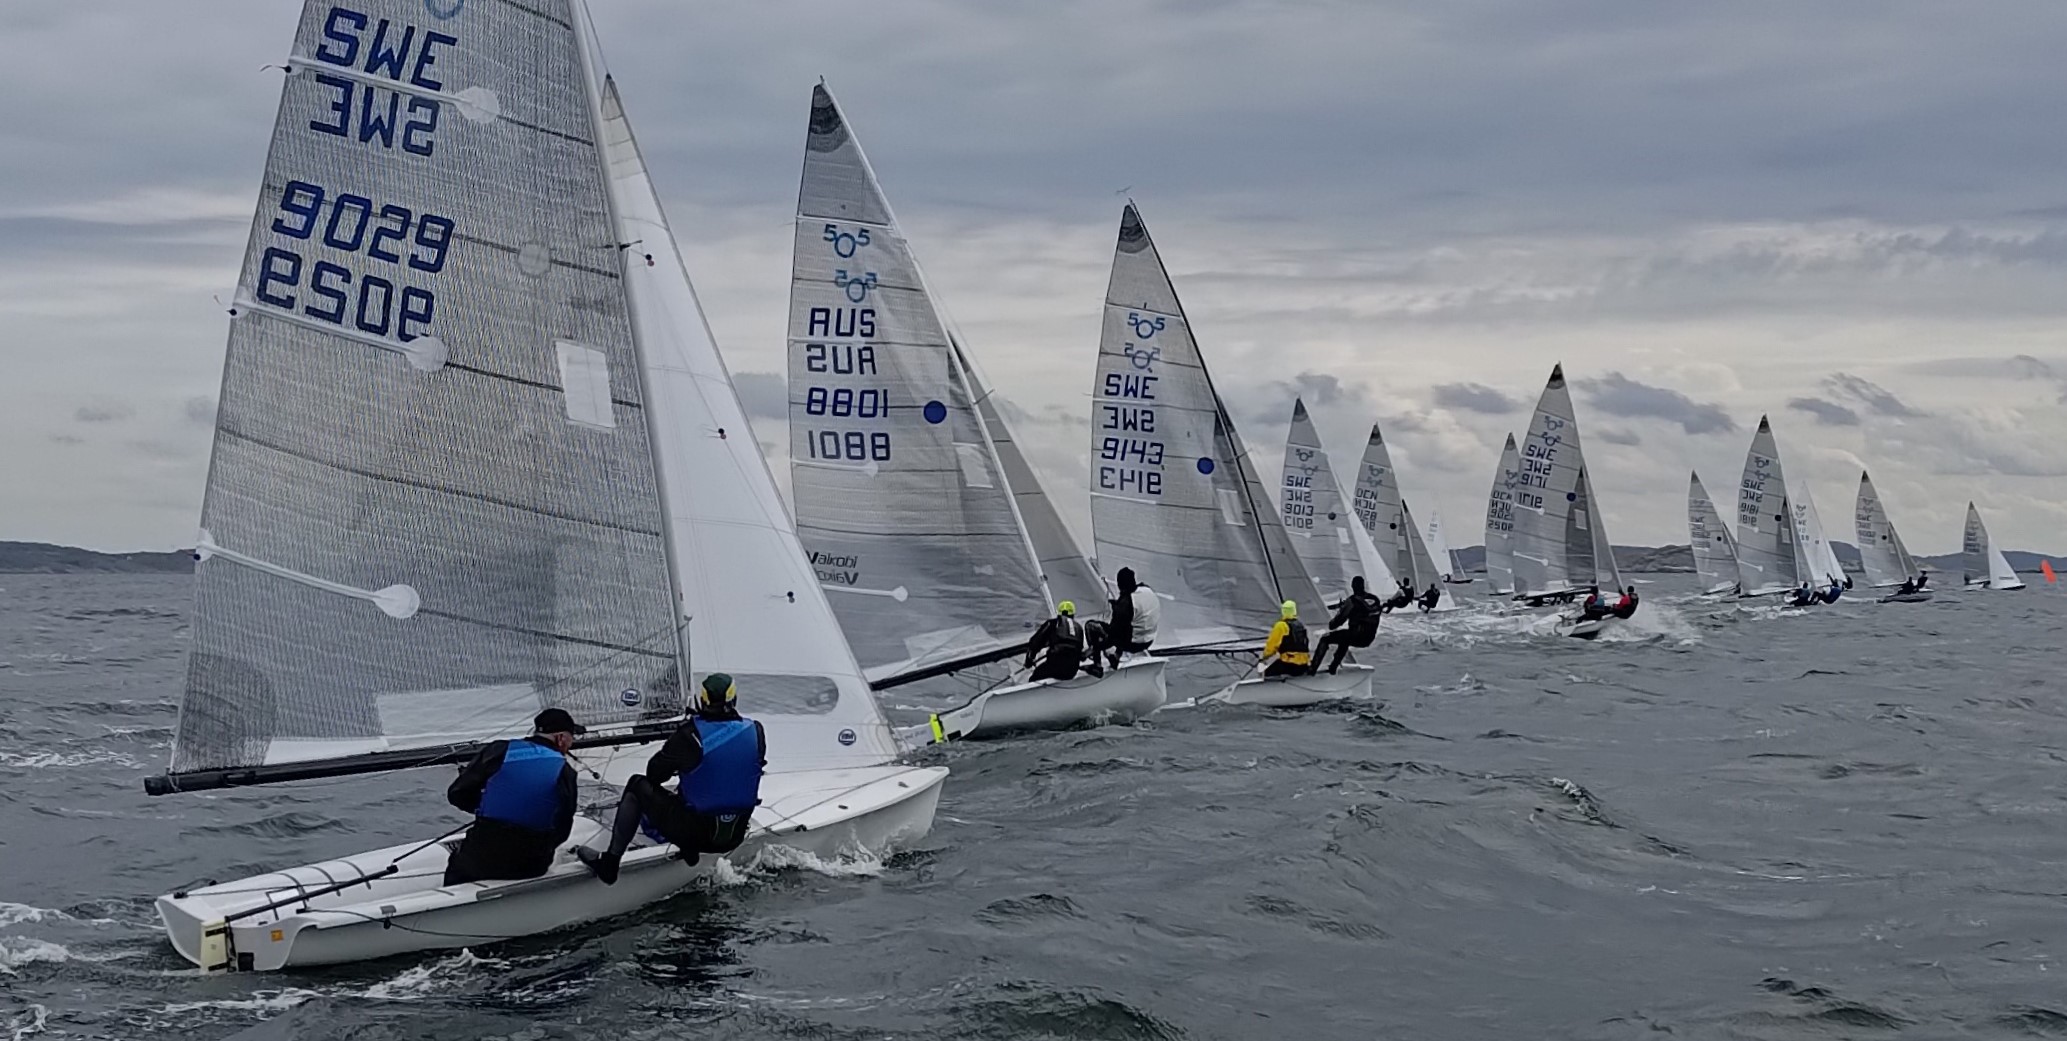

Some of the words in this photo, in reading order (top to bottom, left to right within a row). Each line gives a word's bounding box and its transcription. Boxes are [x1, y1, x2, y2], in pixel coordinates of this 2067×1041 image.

[316, 7, 457, 92] SWE
[271, 180, 455, 273] 9029
[809, 308, 876, 338] AUS
[1104, 374, 1158, 399] SWE
[807, 387, 888, 418] 8801
[1102, 438, 1164, 465] 9143
[1526, 445, 1557, 461] SWE
[1287, 476, 1312, 488] SWE
[1521, 474, 1548, 488] 9171
[1285, 504, 1314, 516] 9013
[1491, 509, 1515, 521] 902
